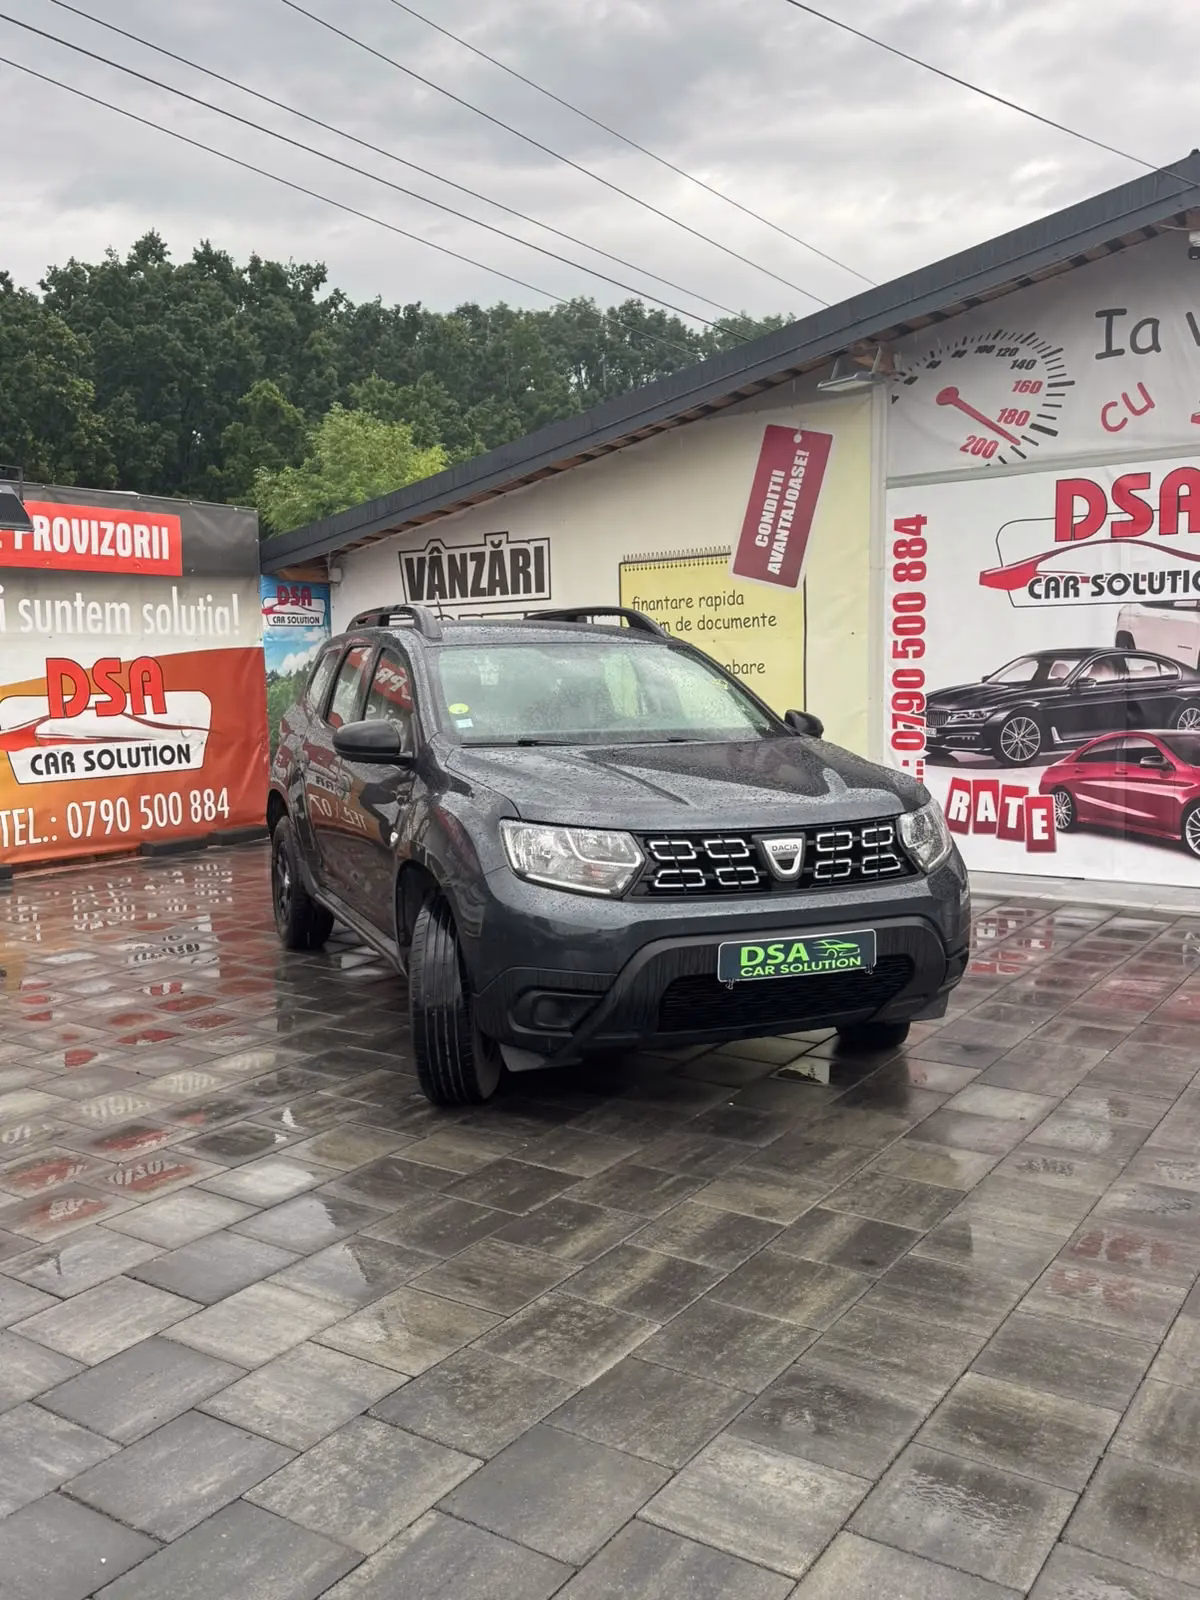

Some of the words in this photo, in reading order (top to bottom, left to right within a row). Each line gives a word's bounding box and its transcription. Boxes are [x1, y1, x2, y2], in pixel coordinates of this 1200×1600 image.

[1095, 308, 1162, 360] Ia
[995, 347, 1019, 357] 120
[1010, 359, 1037, 370] 140
[1011, 380, 1043, 394] 160
[996, 408, 1031, 427] 180
[1101, 381, 1156, 432] cu
[959, 434, 999, 459] 200
[755, 469, 785, 547] CONDITII
[767, 449, 810, 575] AVANTAJOASE!
[1055, 466, 1200, 542] DSA
[892, 514, 928, 583] 884
[404, 540, 546, 601] VÂNZĂRI
[276, 585, 312, 606] DSA
[631, 596, 694, 611] finantare
[698, 590, 744, 611] rapida
[1028, 575, 1080, 600] CAR
[18, 592, 132, 634] suntem
[142, 585, 240, 636] solutia!
[272, 616, 285, 624] CAR
[287, 615, 320, 624] SOLUTION
[675, 616, 692, 632] de
[697, 612, 777, 630] documente
[891, 591, 927, 660] 500
[723, 659, 766, 675] obare
[46, 656, 168, 719] DSA
[891, 668, 926, 751] 0790
[30, 751, 76, 776] CAR
[83, 743, 191, 772] SOLUTION
[0, 807, 57, 848] TEL.:
[66, 796, 131, 839] 0790
[140, 791, 183, 830] 500
[189, 787, 230, 823] 884
[947, 786, 1051, 843] RATE
[771, 844, 799, 852] DACIA
[740, 942, 810, 966] DSA
[740, 965, 775, 977] CAR
[780, 956, 862, 974] SOLUTION
